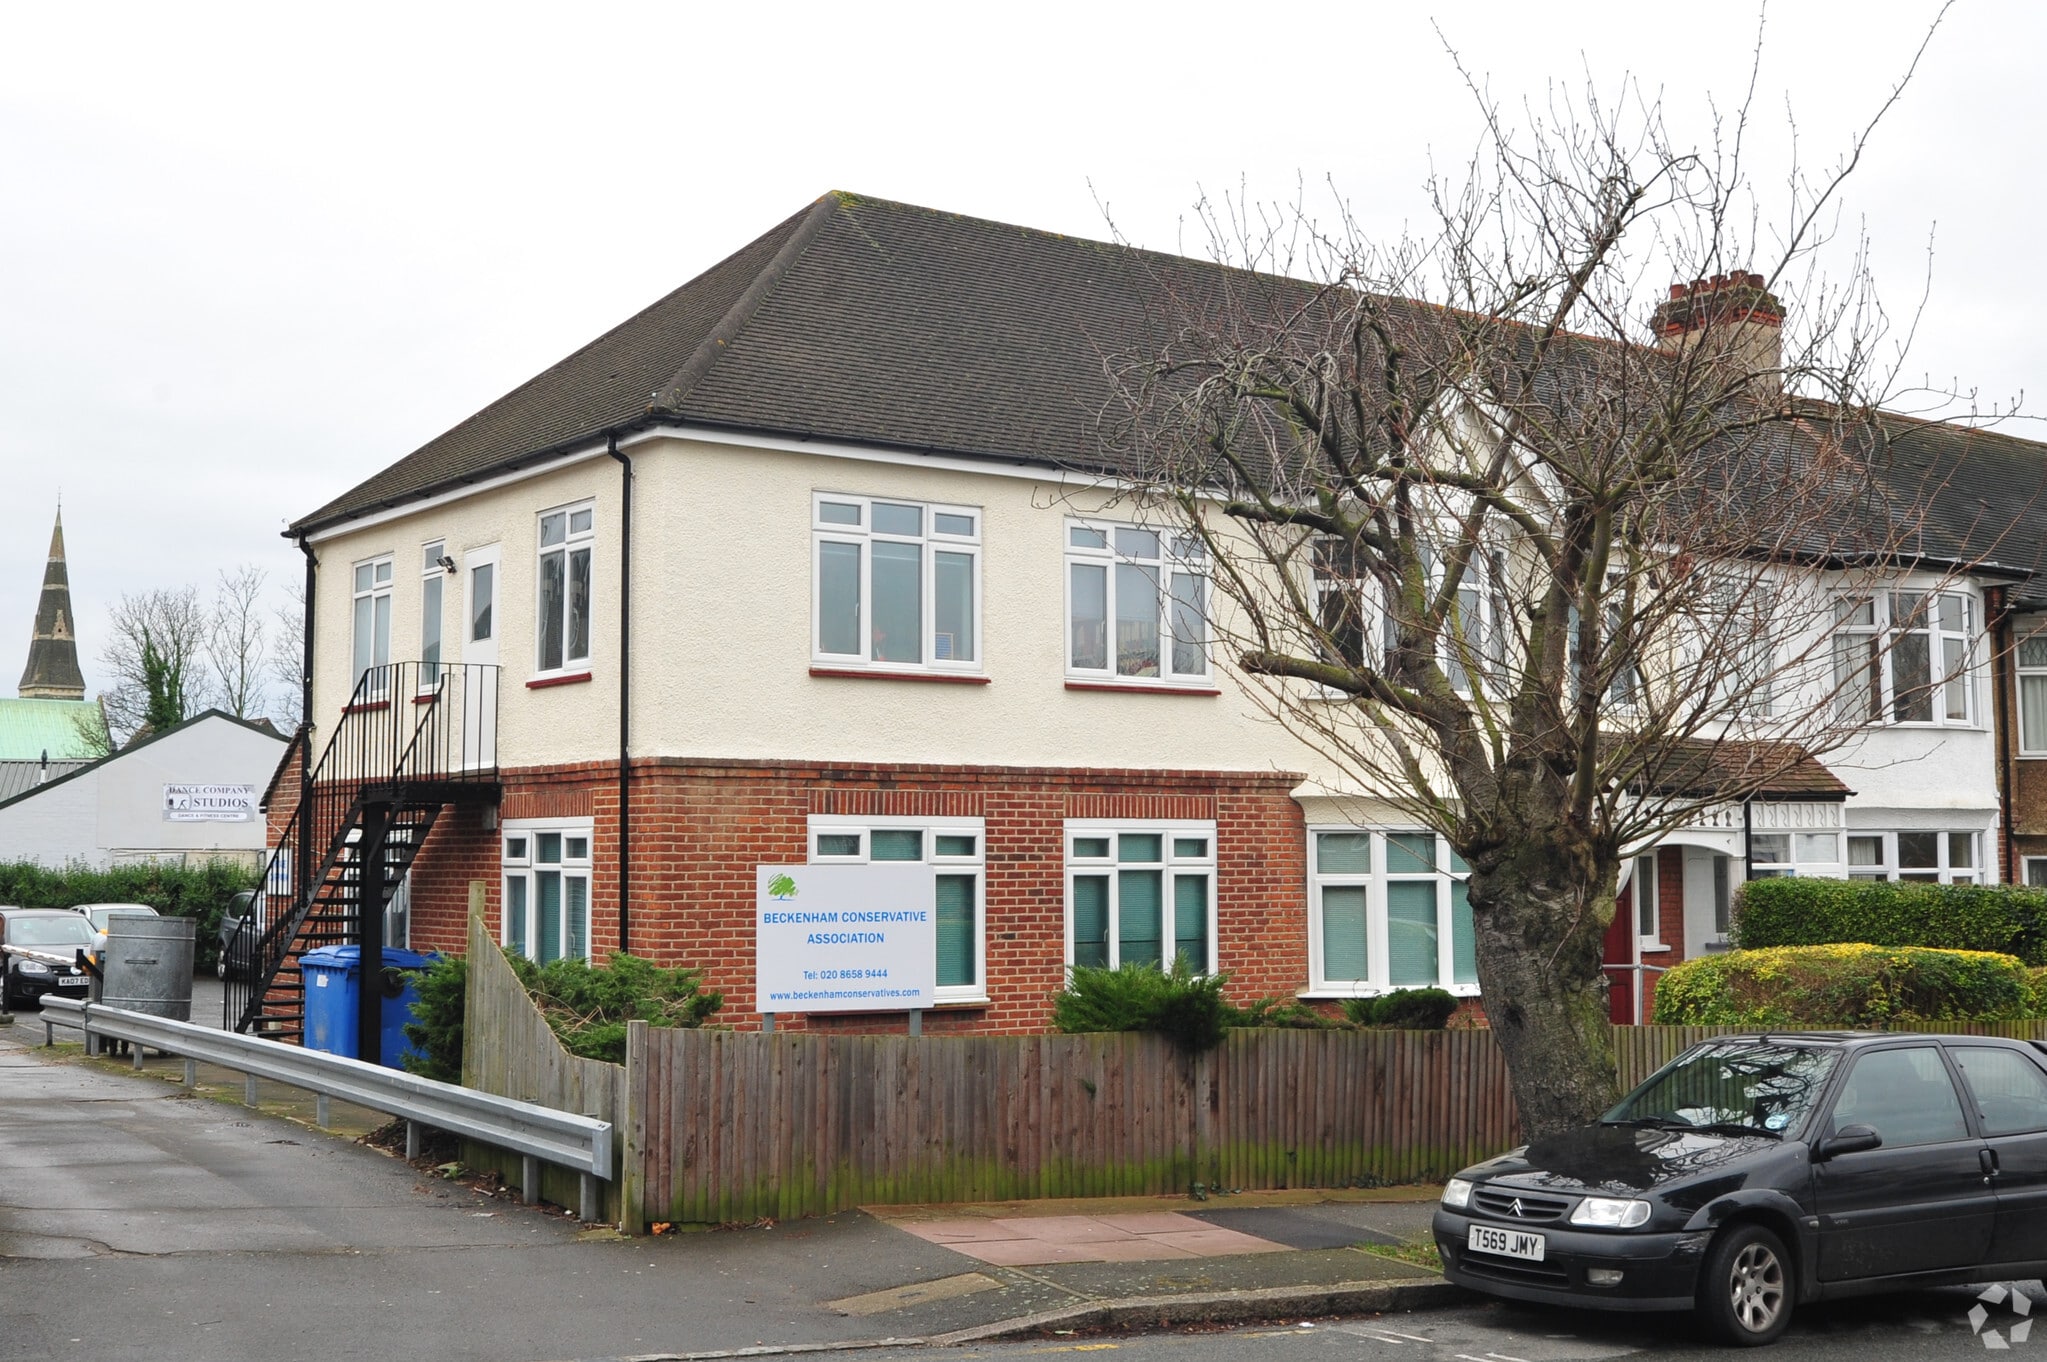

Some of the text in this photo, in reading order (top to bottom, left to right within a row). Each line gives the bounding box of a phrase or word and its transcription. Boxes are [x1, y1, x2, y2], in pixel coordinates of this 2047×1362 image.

[169, 786, 201, 794] DANCE
[193, 798, 249, 808] STUDIOS
[763, 911, 927, 924] BECKENHAM CONSERVATIVE
[807, 932, 885, 944] ASSOCIATION
[803, 969, 888, 980] Tel: 020 8658 9444
[770, 988, 920, 1000] www.beckenhamconservatives.com
[1475, 1228, 1538, 1256] T569 JMY
